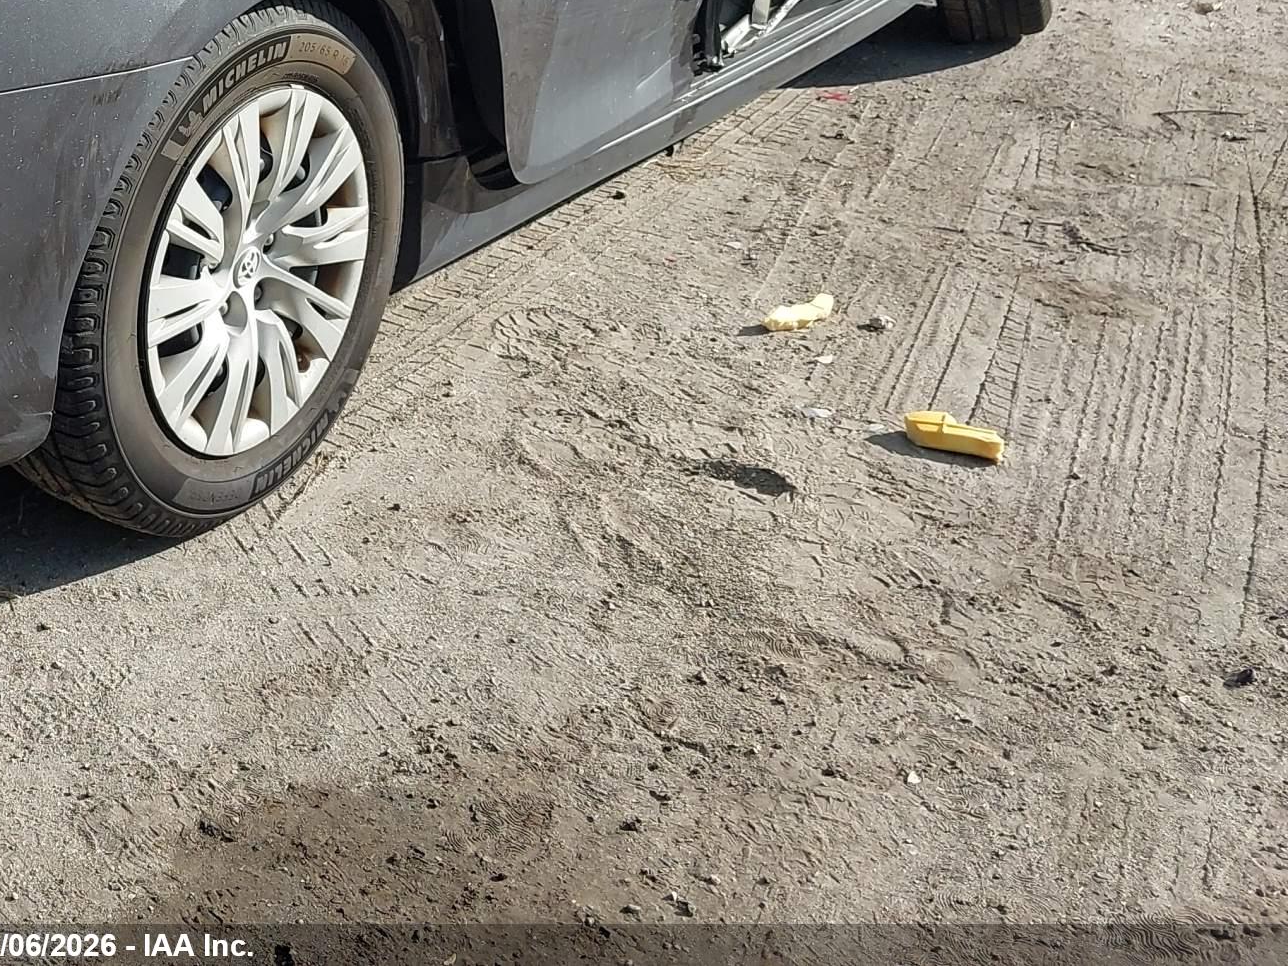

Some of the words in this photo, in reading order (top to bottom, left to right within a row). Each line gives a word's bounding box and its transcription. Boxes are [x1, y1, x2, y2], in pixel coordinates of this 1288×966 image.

[201, 41, 287, 114] MICHELIN
[299, 41, 331, 56] 205/65
[255, 412, 330, 495] MICHELIN
